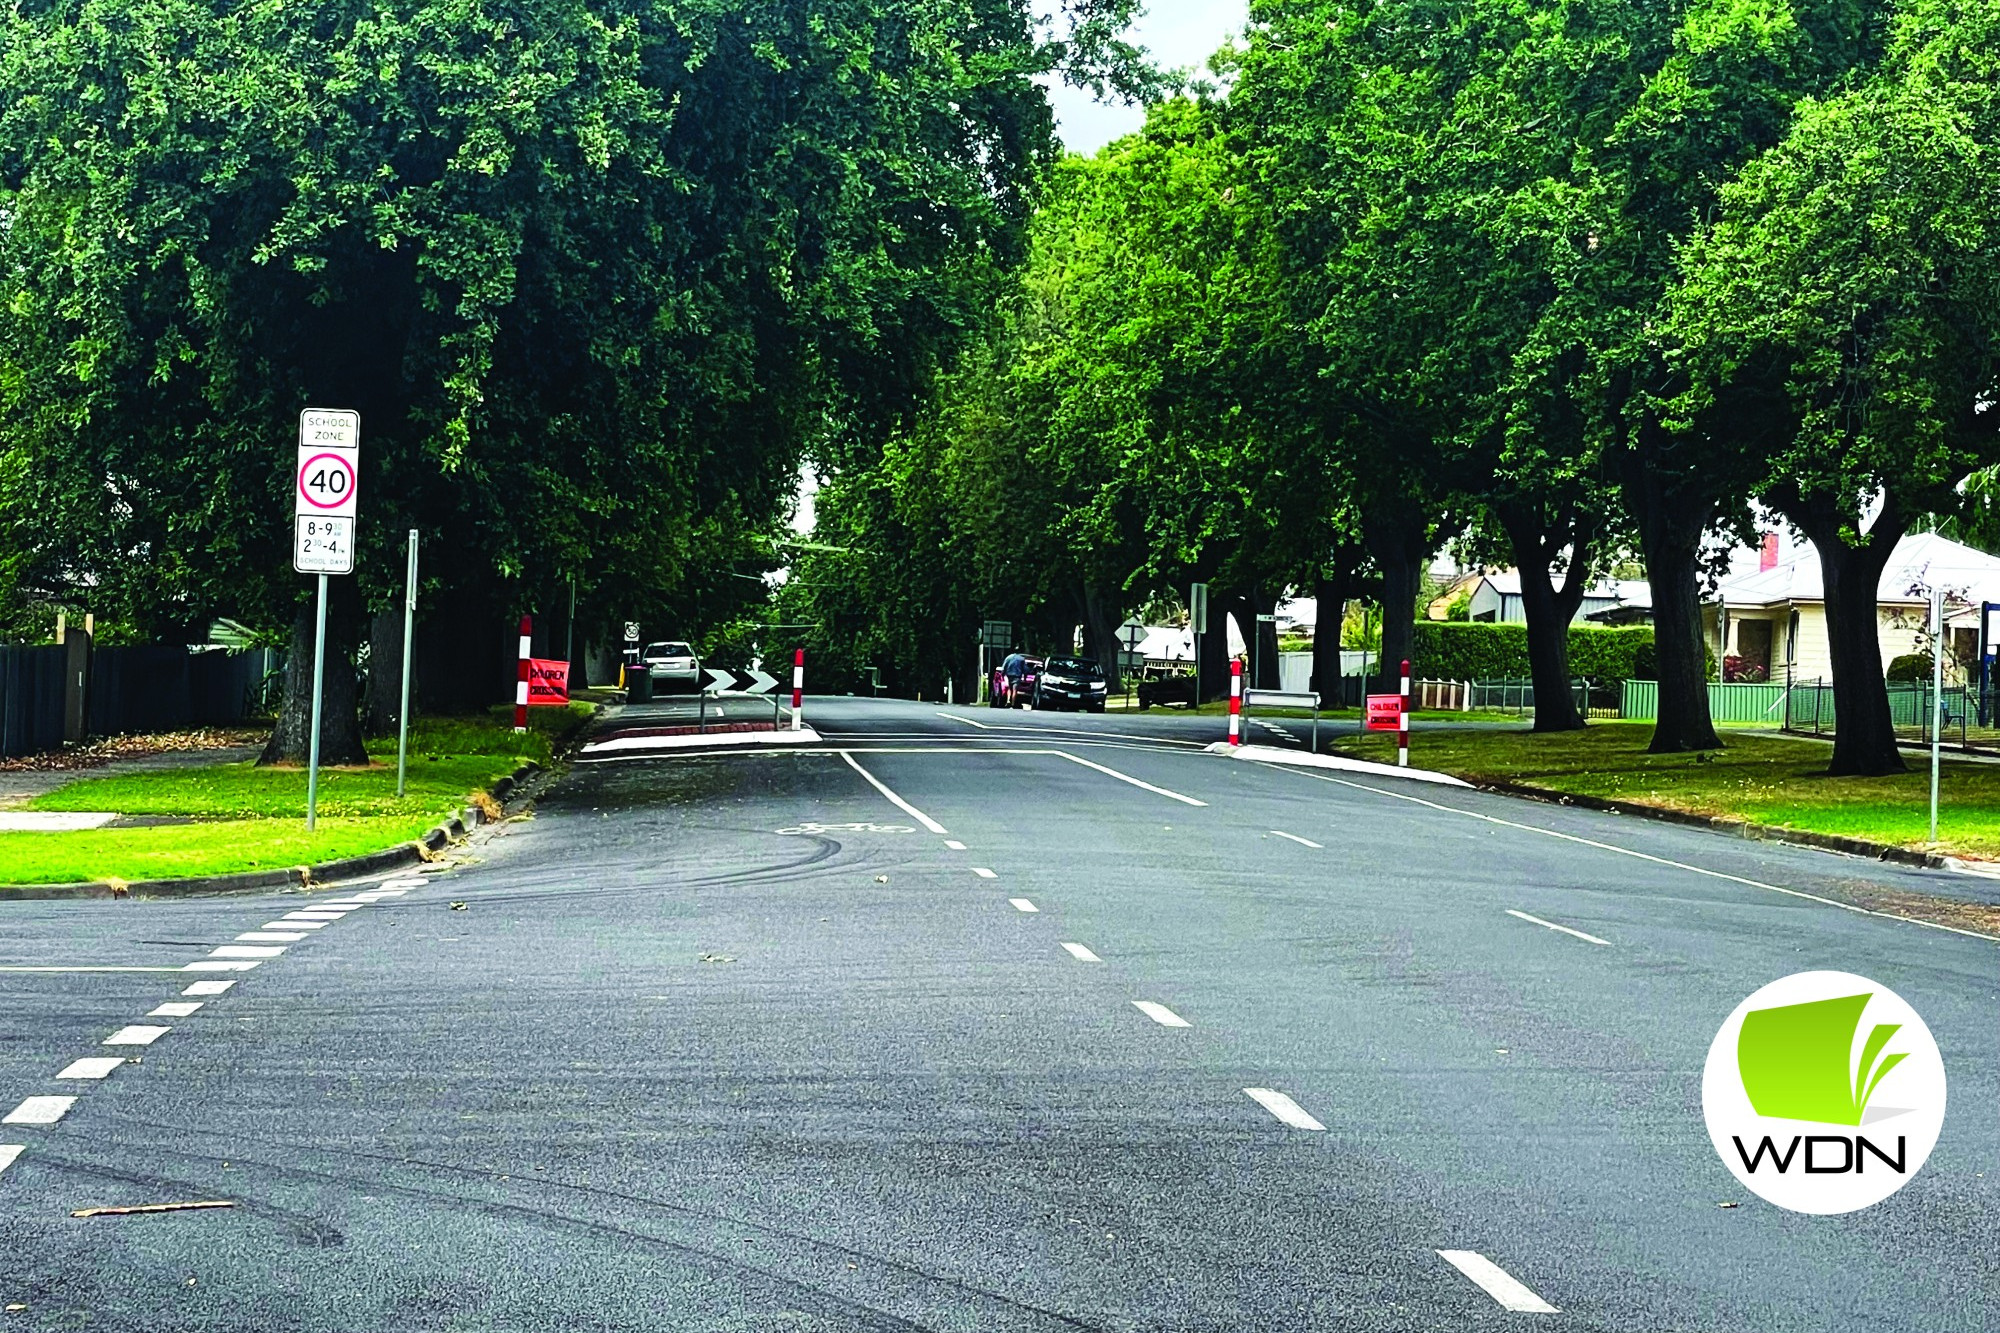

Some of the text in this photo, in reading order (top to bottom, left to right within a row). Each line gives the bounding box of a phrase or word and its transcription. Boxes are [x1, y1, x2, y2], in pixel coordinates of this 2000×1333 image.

[308, 417, 352, 428] SCHOOL
[315, 431, 344, 441] ZONE
[309, 470, 346, 494] 40
[300, 557, 348, 566] SCHOOL DAYS
